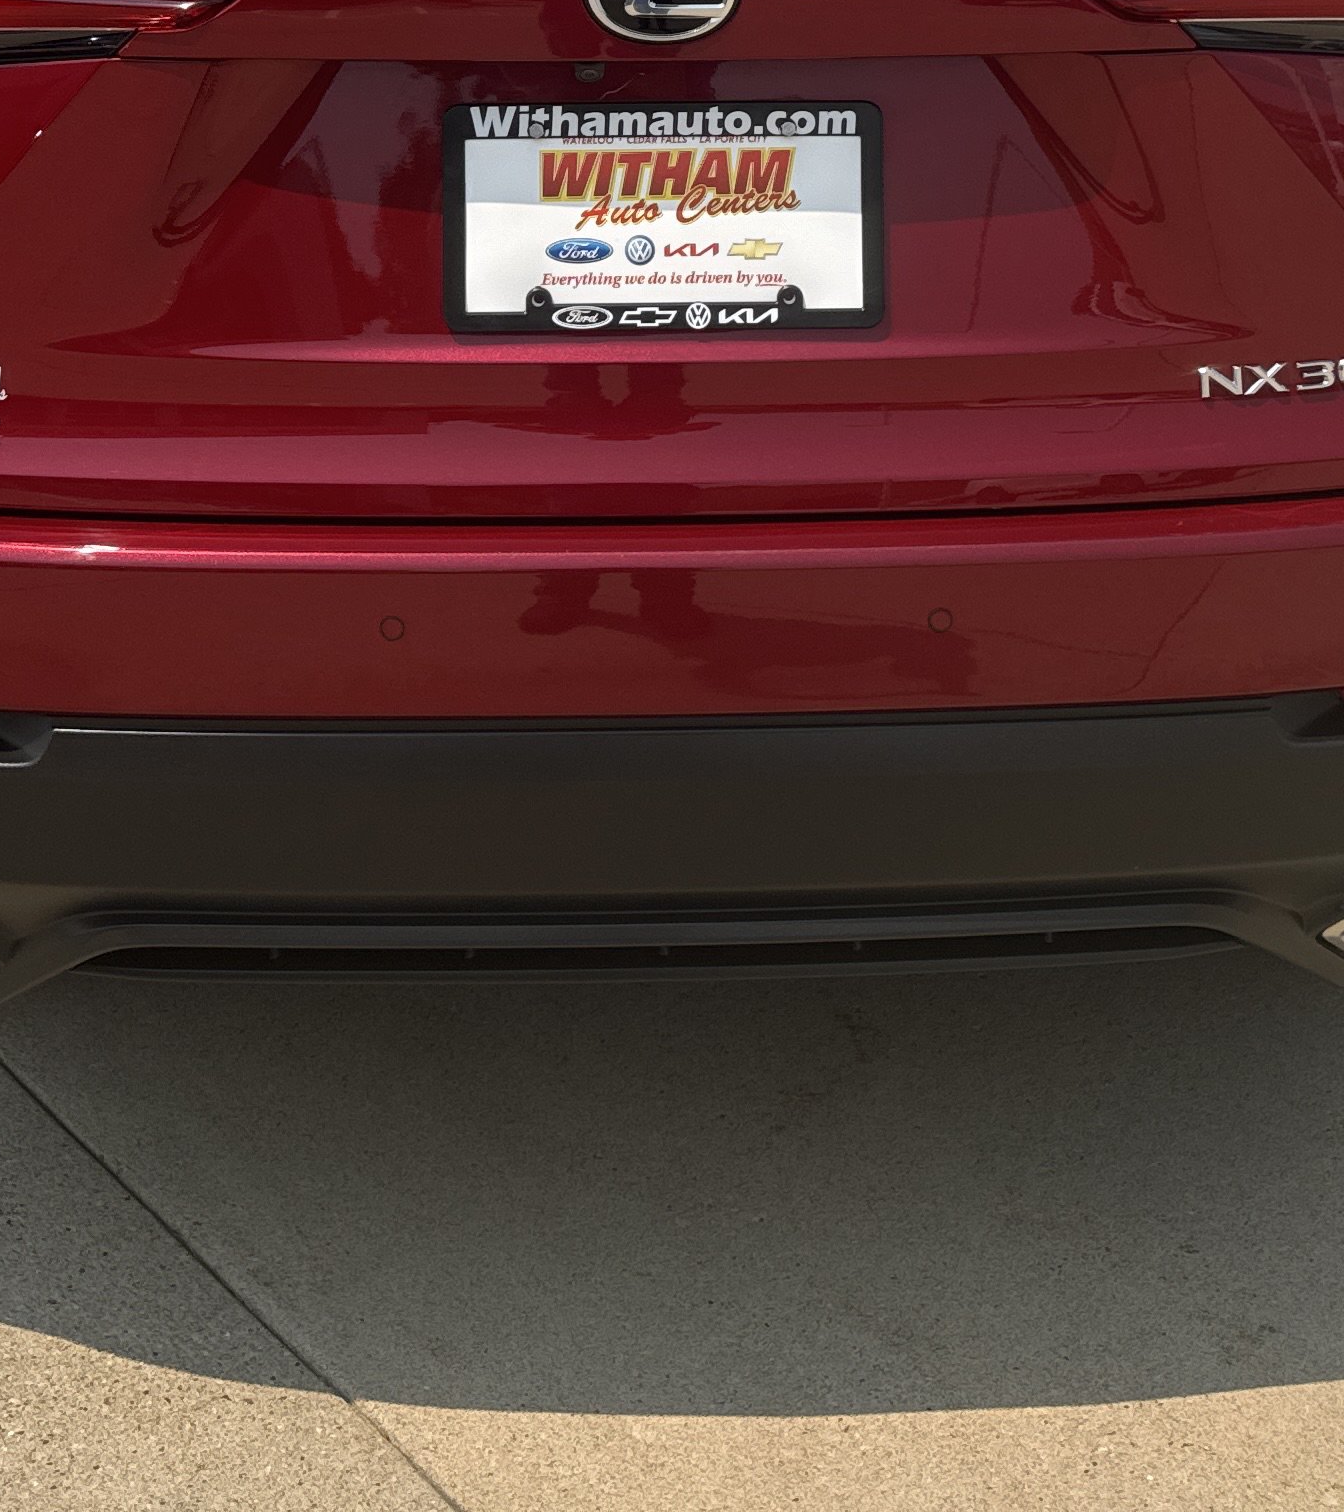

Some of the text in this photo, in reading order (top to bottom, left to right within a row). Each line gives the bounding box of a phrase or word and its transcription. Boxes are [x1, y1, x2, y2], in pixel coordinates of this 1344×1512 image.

[470, 105, 856, 138] Withamauto.com
[562, 137, 614, 145] WATERLOO
[699, 136, 711, 144] LA
[540, 148, 796, 201] WITHAM
[575, 184, 801, 231] Auto Centers
[541, 270, 787, 289] Everything we do is driven by you.
[1197, 362, 1290, 398] NX
